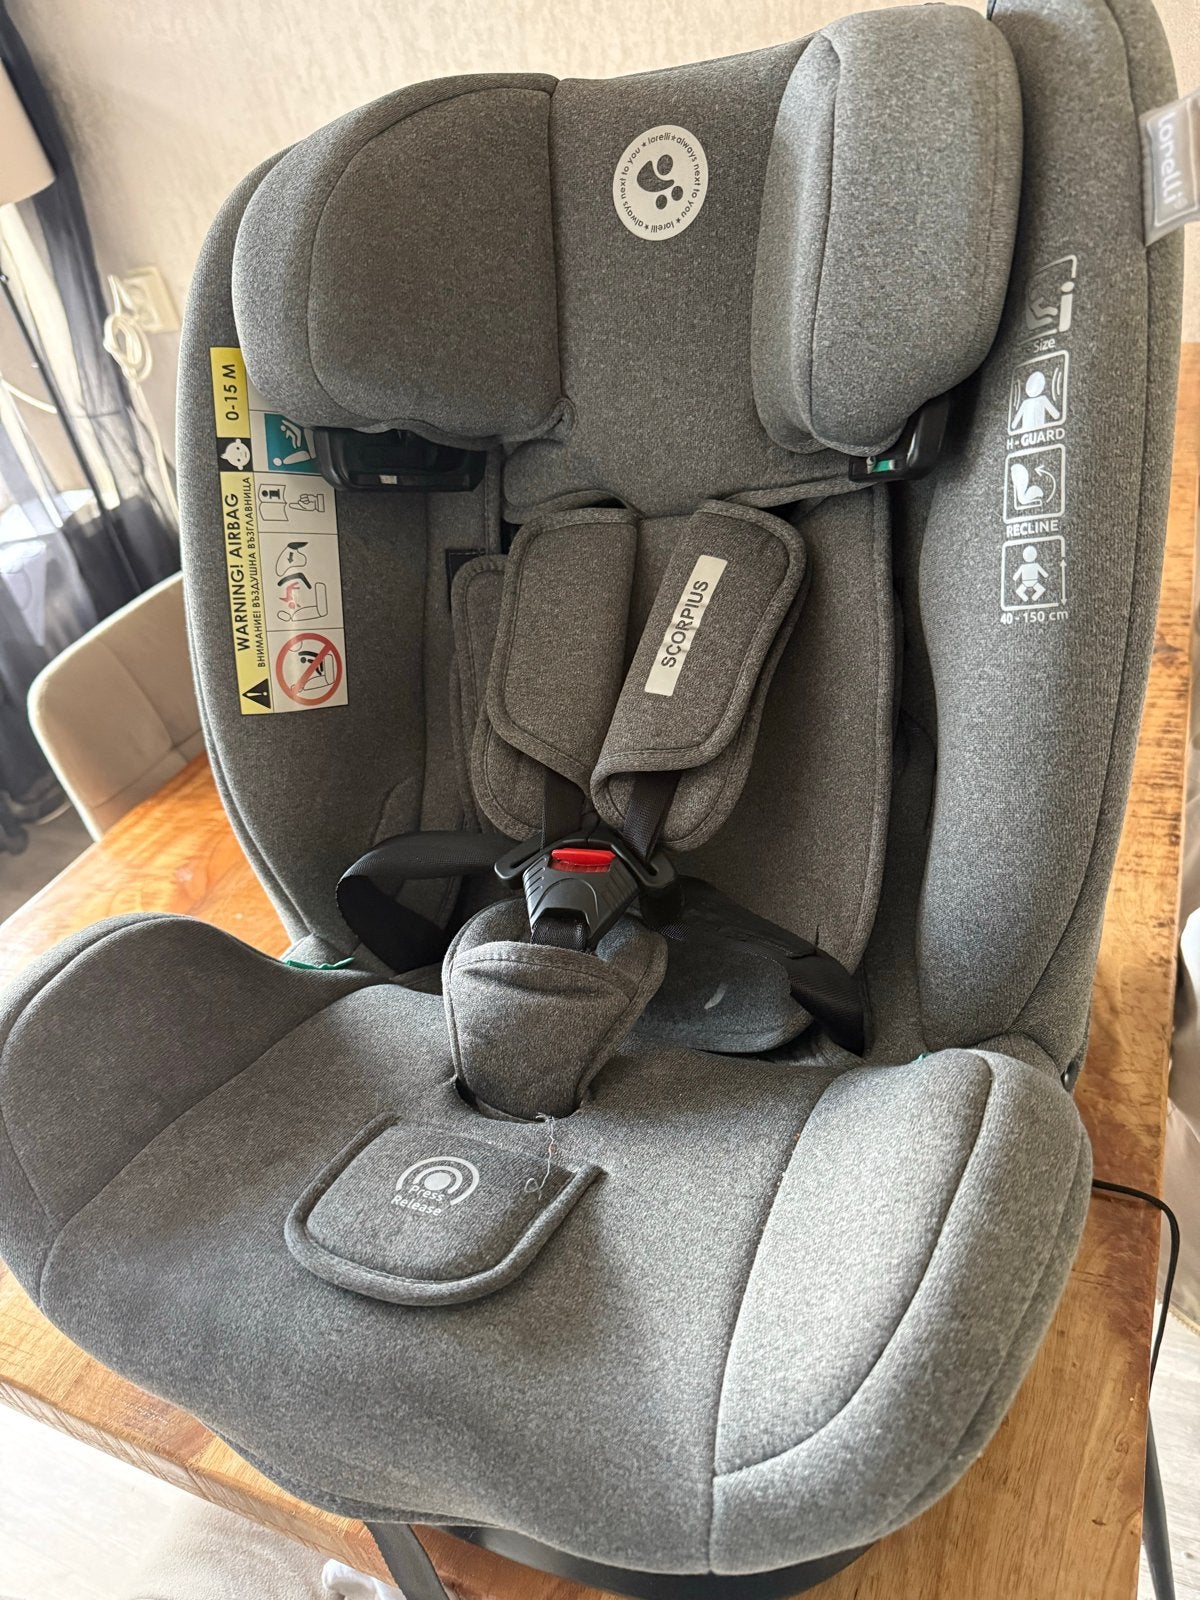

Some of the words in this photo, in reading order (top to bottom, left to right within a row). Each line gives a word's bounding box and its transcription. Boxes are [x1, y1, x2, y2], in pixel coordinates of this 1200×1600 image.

[648, 132, 671, 144] lorelli
[627, 147, 641, 165] you
[676, 137, 698, 162] always
[621, 165, 630, 176] to
[693, 163, 702, 186] next
[691, 188, 701, 198] to
[622, 201, 643, 227] always
[681, 200, 694, 218] you
[651, 221, 675, 233] lorelli
[222, 364, 237, 379] M
[242, 476, 256, 549] ВЪЗГЛАВНИЦА
[224, 493, 244, 559] AIRBAG
[1006, 520, 1059, 538] RECLINE
[248, 552, 262, 608] ВЪЗДУШНА
[230, 564, 251, 652] WARNING!
[1049, 610, 1069, 622] cm
[661, 580, 709, 668] SCORPIUS
[251, 610, 266, 668] ВНИМАНИЕ!
[408, 1185, 445, 1201] Press
[391, 1194, 442, 1216] Release
